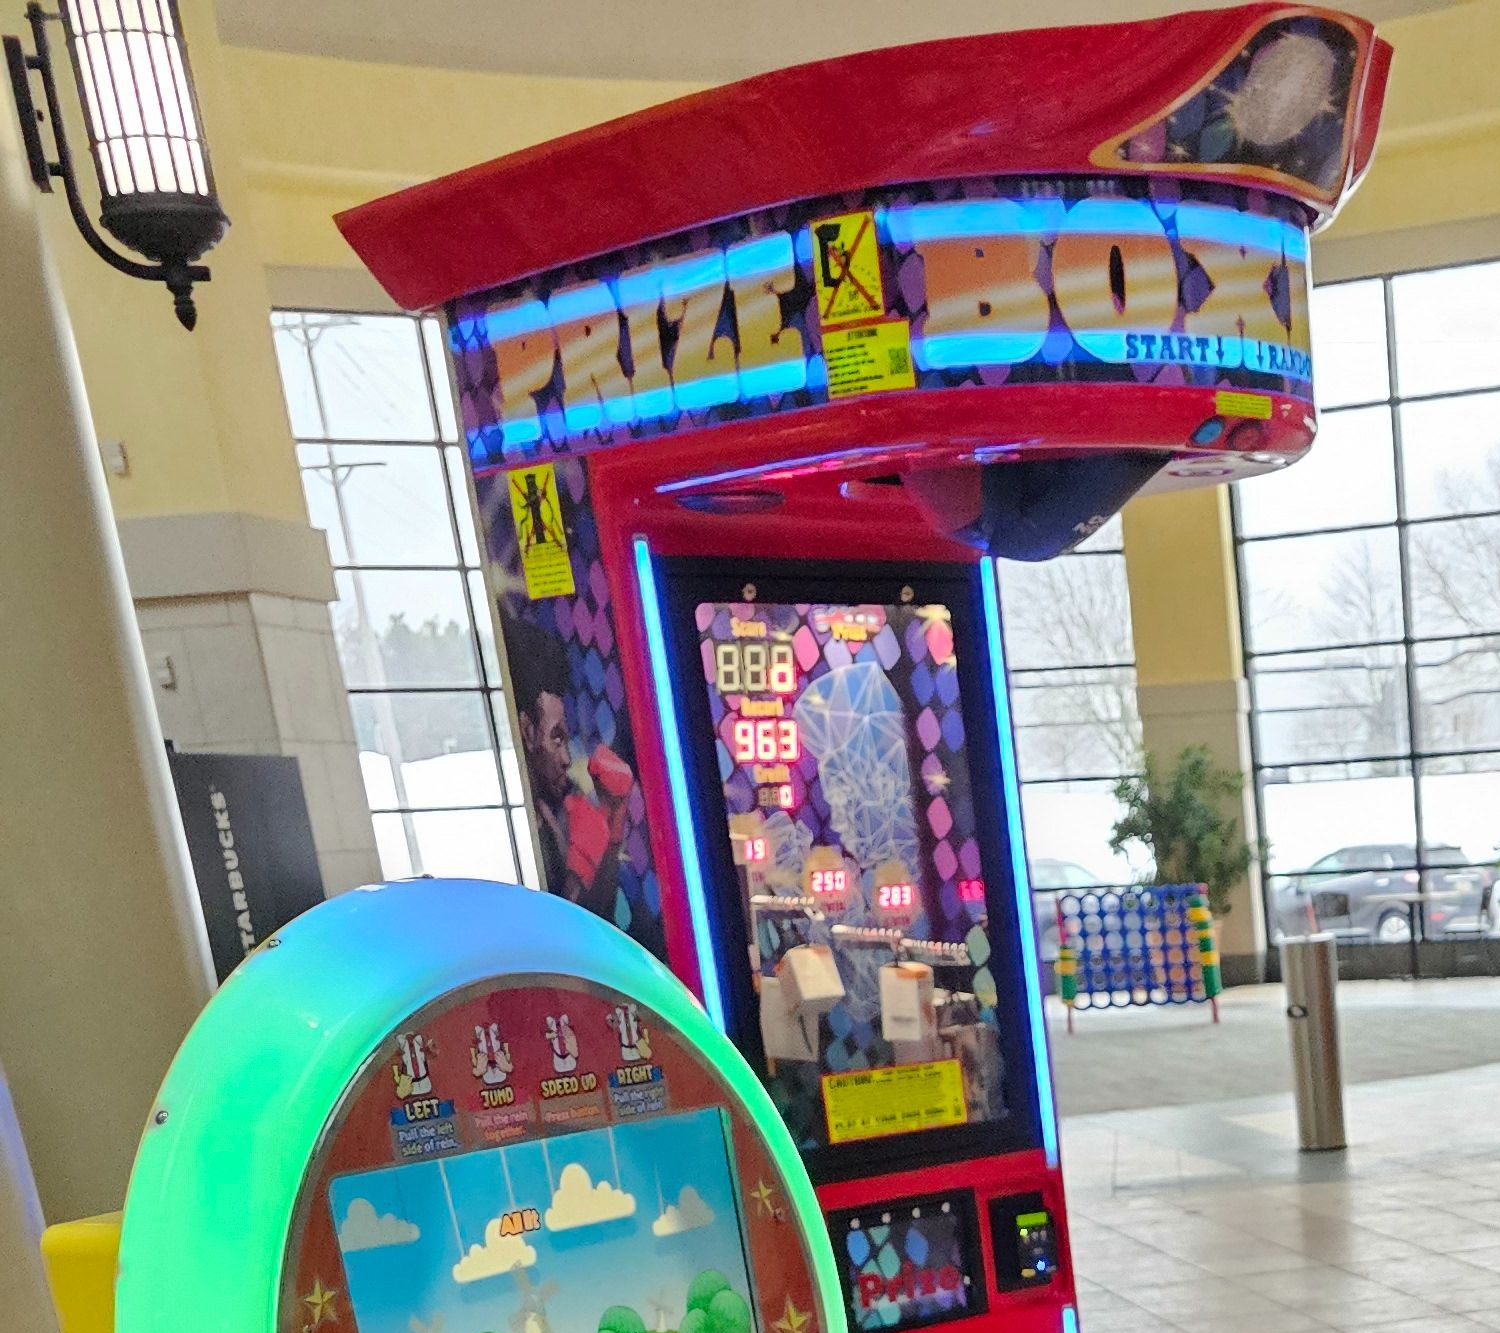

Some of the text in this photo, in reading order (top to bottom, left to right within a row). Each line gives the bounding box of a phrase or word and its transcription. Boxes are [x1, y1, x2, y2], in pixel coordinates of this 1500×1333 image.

[486, 198, 1311, 446] PRIZE BOX
[1126, 334, 1210, 362] START
[734, 720, 798, 761] 963
[744, 838, 766, 860] 19
[210, 790, 256, 957] TARBUCKS
[540, 1073, 597, 1098] SPEED UP
[616, 1064, 653, 1085] RIGHT
[480, 1086, 514, 1108] JUMP
[404, 1099, 439, 1121] LEFT
[398, 1122, 454, 1141] Pull the left
[401, 1142, 422, 1156] side
[424, 1140, 435, 1152] of
